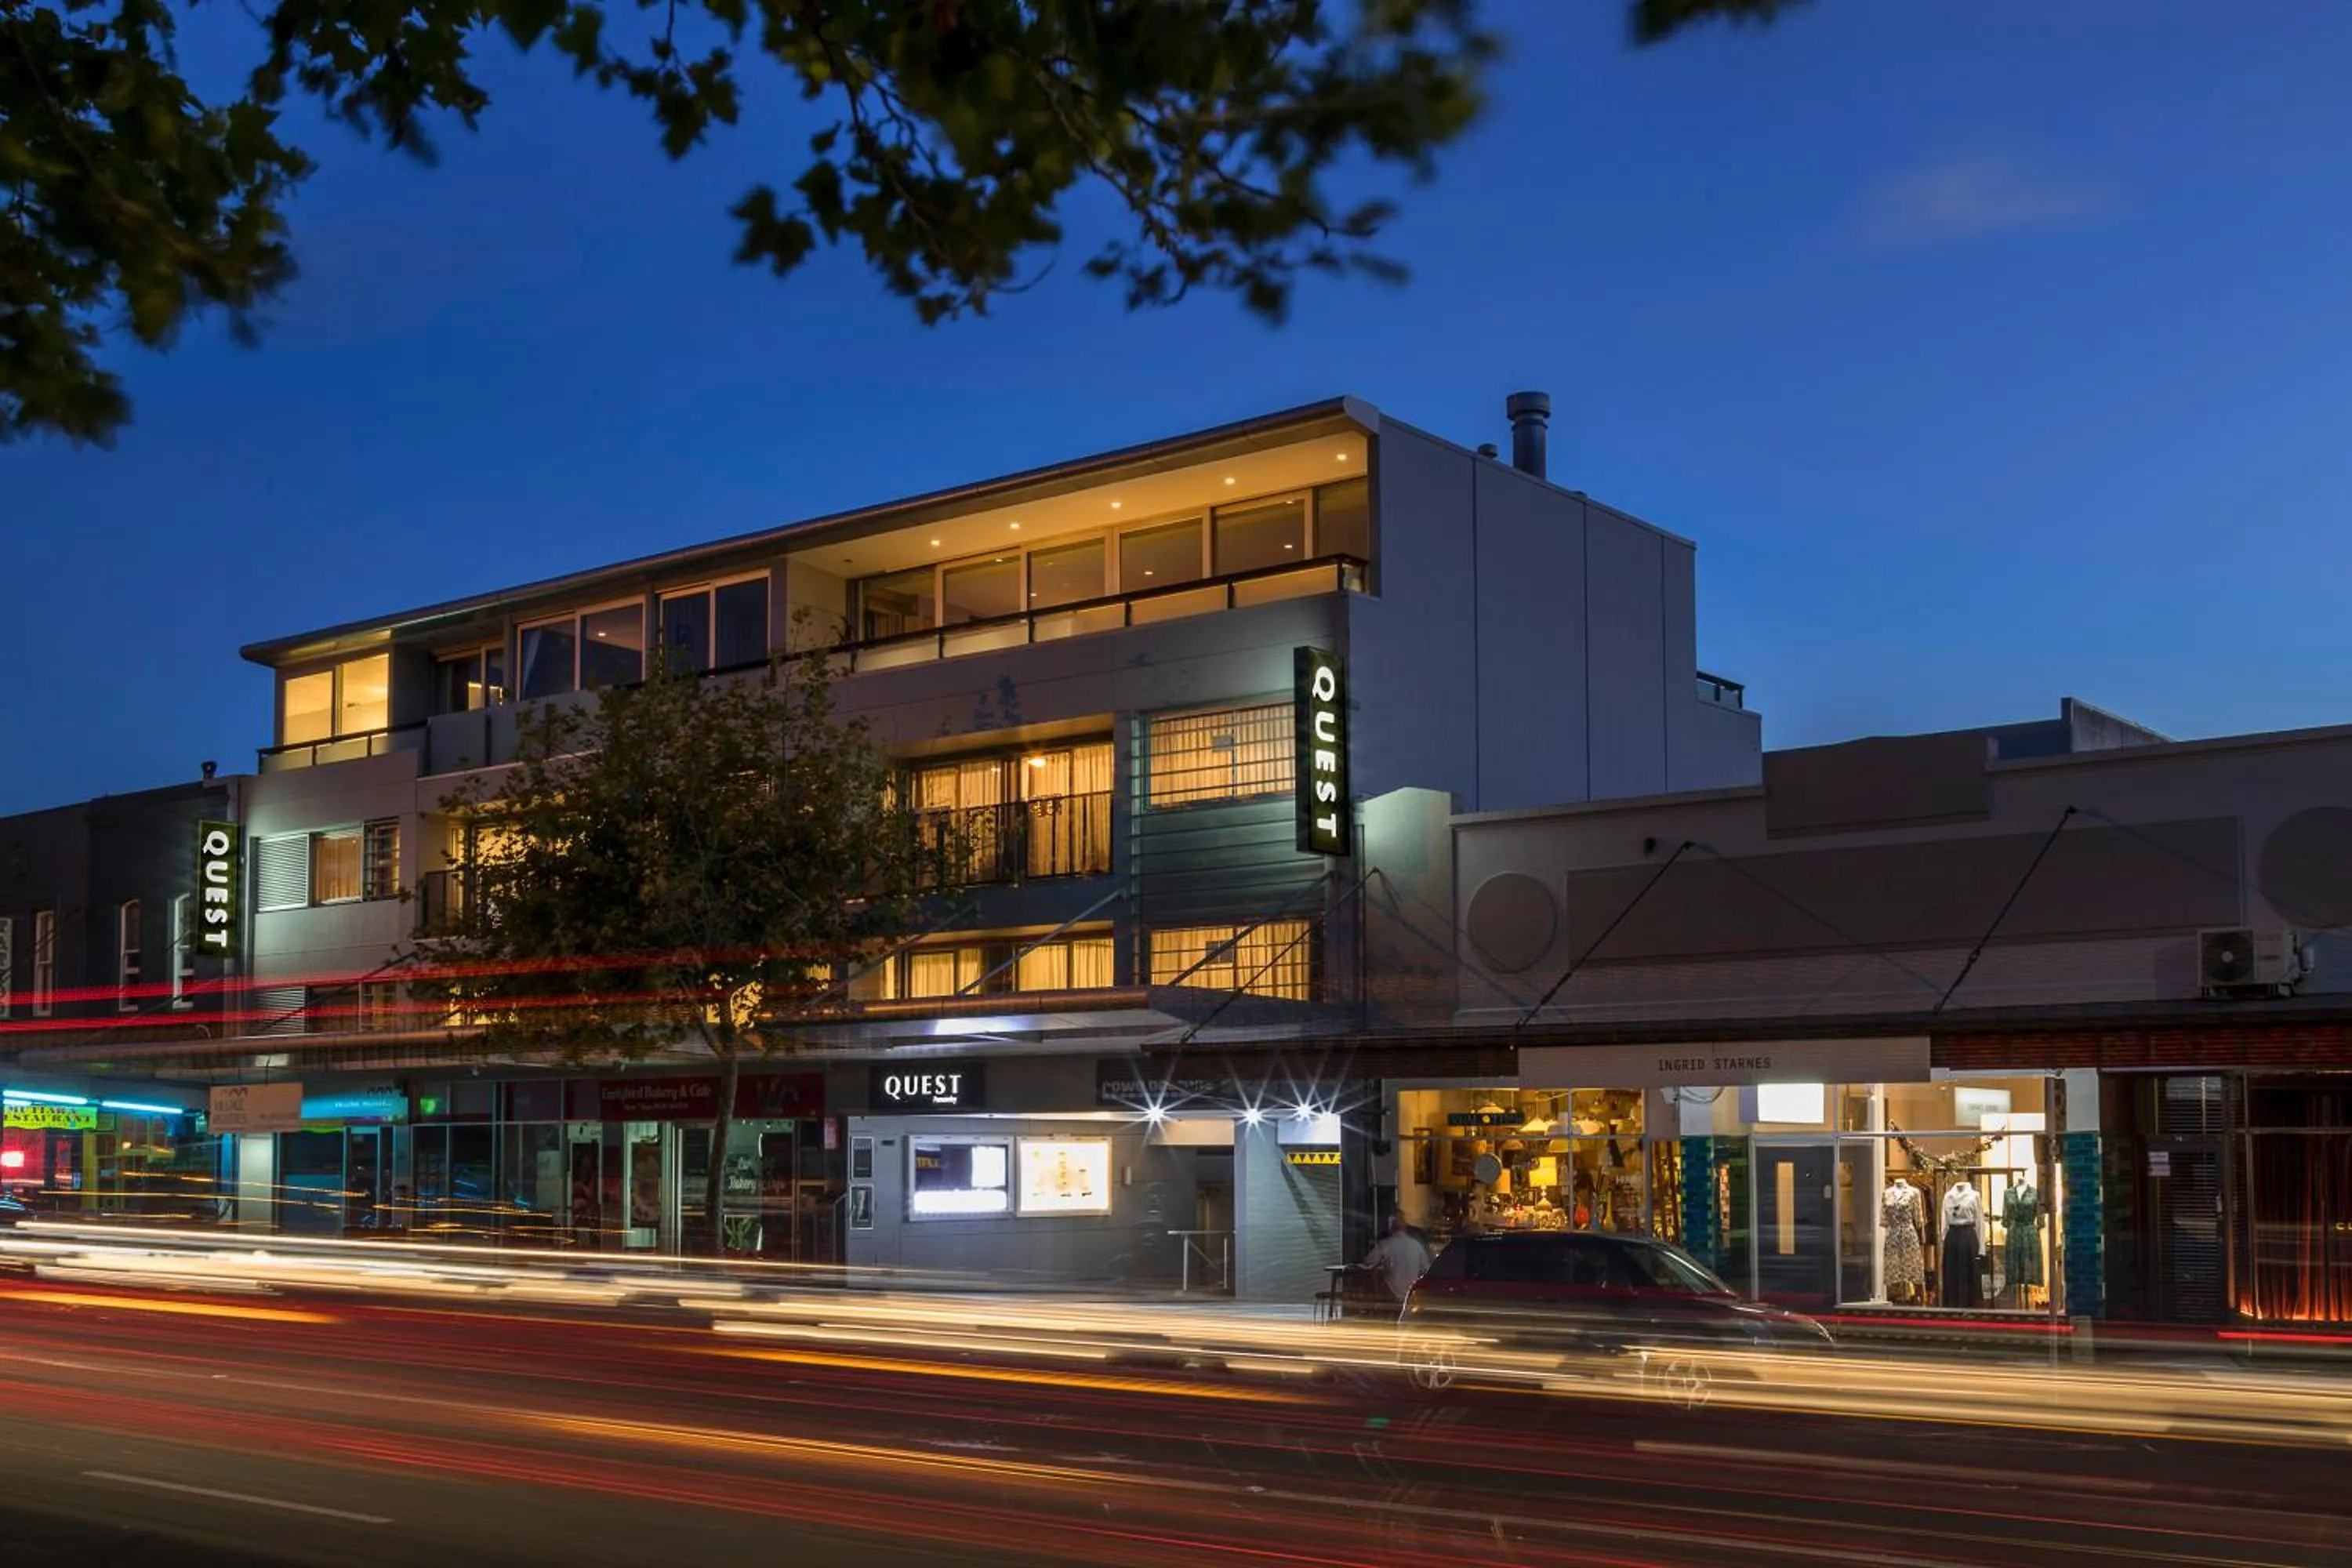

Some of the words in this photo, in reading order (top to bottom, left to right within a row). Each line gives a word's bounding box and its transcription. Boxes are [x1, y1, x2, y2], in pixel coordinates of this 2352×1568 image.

[1312, 665, 1337, 838] QUEST
[203, 830, 230, 948] QUEST
[884, 1074, 962, 1100] QUEST
[1658, 1058, 1705, 1071] INGRID
[1713, 1057, 1771, 1070] STARNES
